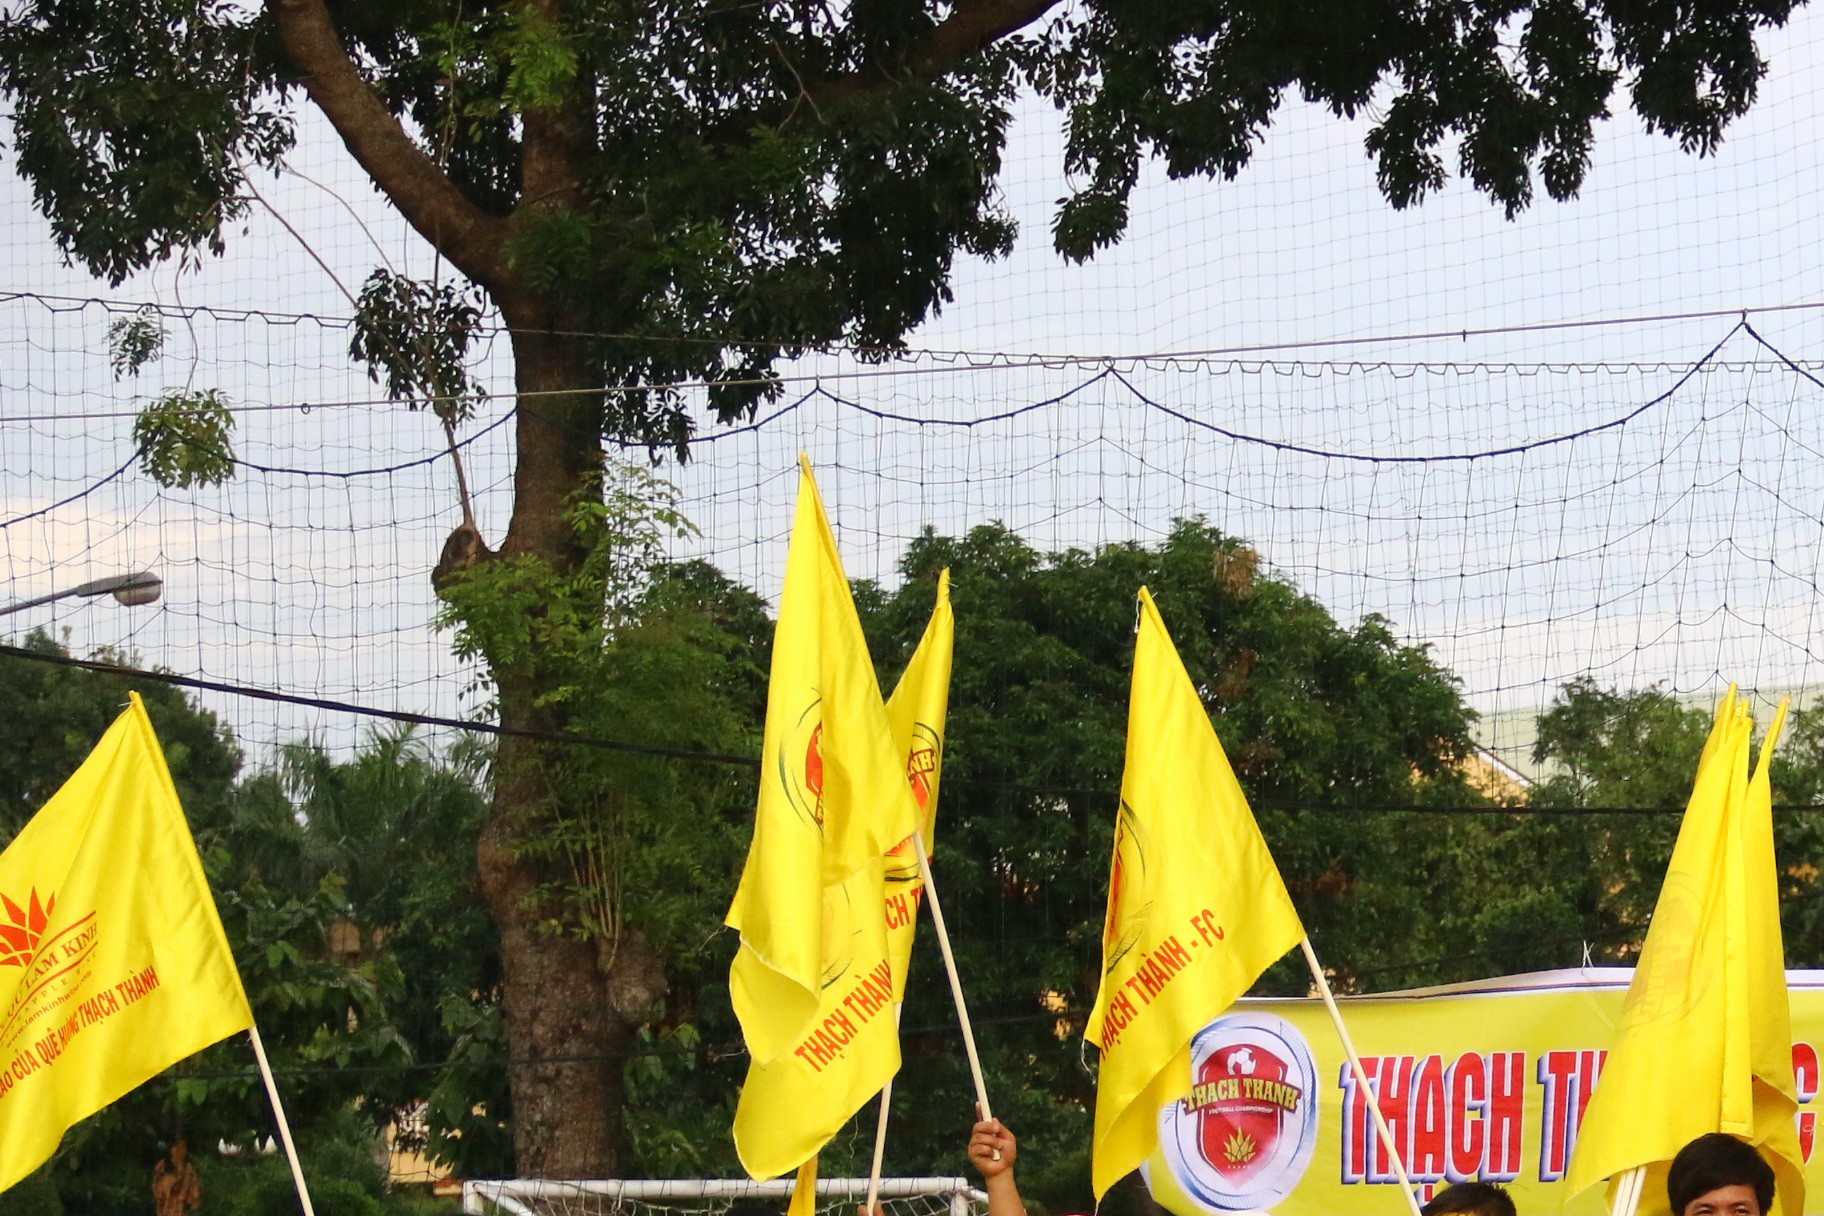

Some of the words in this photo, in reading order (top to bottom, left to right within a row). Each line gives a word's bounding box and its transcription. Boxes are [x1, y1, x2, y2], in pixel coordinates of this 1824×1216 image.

[25, 955, 59, 989] LAM
[60, 922, 97, 958] KINH
[1126, 936, 1192, 1005] THÀNH
[1190, 909, 1225, 948] FC
[78, 989, 120, 1026] THẠCH
[115, 965, 160, 1006] THÀNH
[794, 1009, 858, 1072] THẠCH
[1184, 1078, 1239, 1111] THACH
[1243, 1078, 1299, 1110] THANH
[1343, 1050, 1527, 1203] THẠCH
